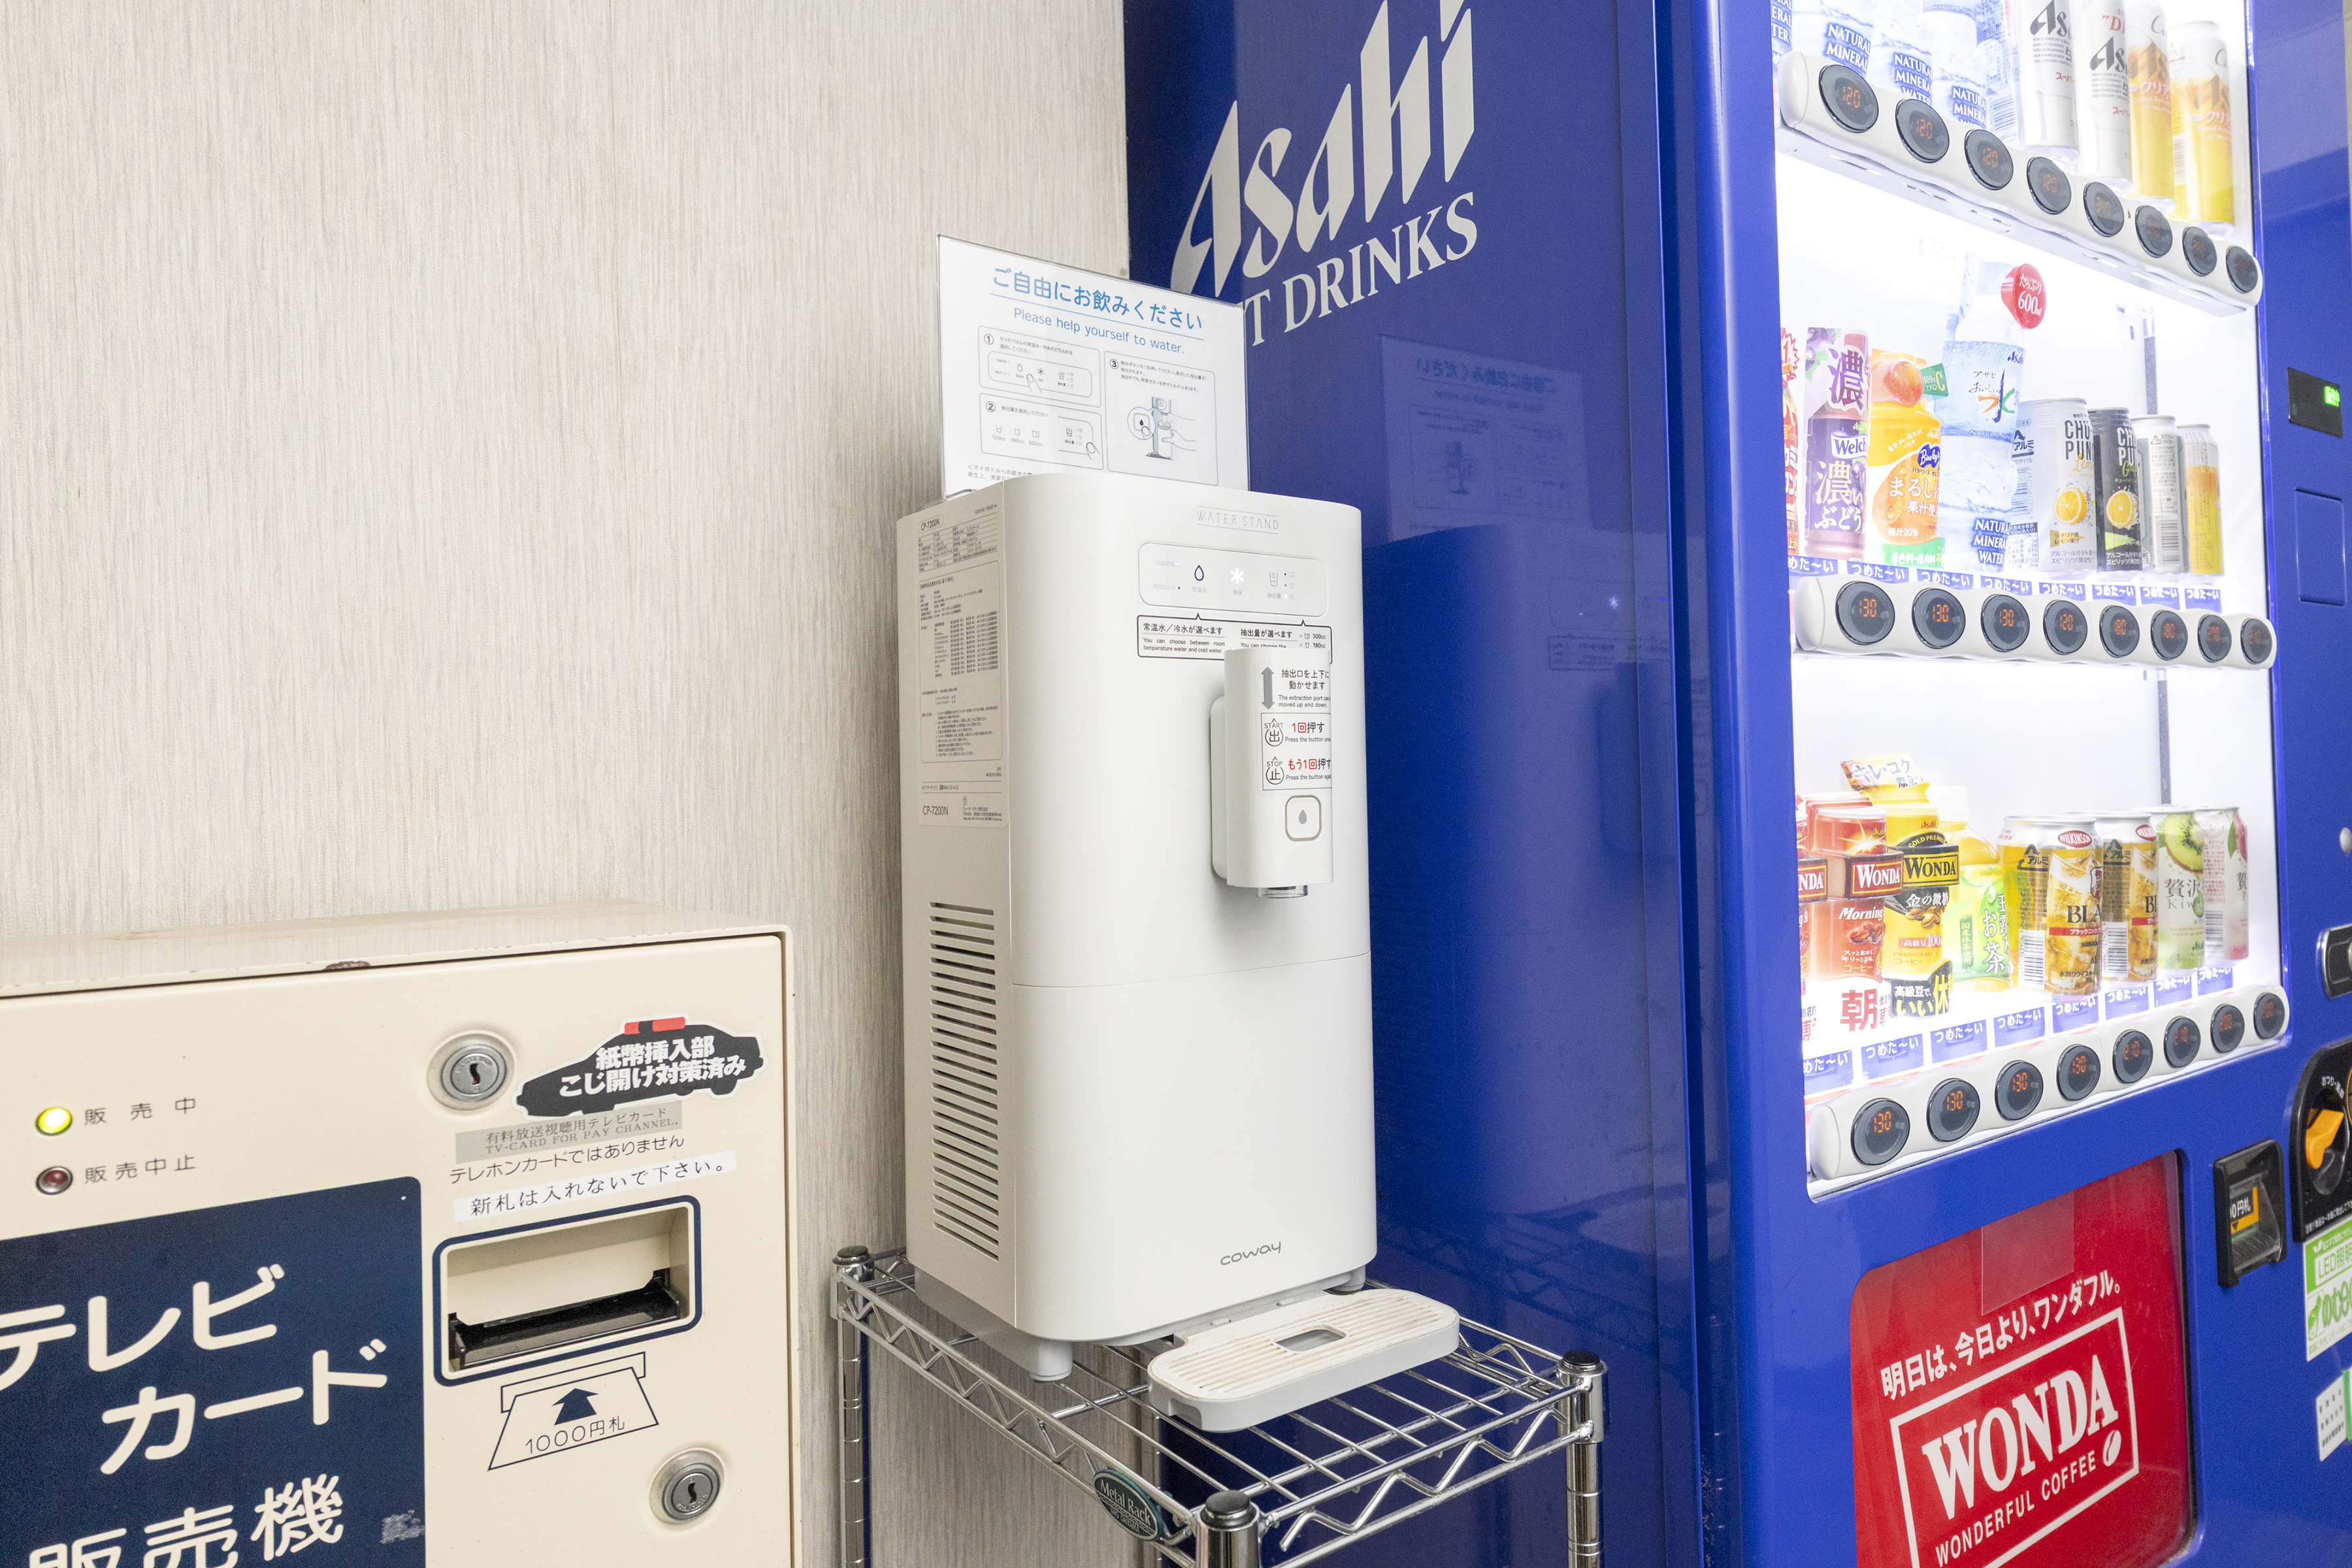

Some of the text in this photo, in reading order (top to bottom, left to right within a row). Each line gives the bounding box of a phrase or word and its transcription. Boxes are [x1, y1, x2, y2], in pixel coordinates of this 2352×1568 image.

[1842, 86, 1861, 109] 120
[1916, 118, 1933, 140] 120
[1170, 0, 1475, 298] Asahi
[1983, 148, 1999, 168] 120
[1282, 191, 1478, 333] DRINKS
[2017, 272, 2043, 295] たっぷり
[992, 267, 1203, 331] ご自由にお飲みください
[1014, 307, 1185, 355] Please help yourself to water.
[1828, 346, 1865, 410] 濃
[1972, 370, 1997, 379] アサヒ
[1968, 382, 1999, 393] おいしい
[1978, 368, 2016, 423] 水
[2014, 440, 2034, 451] アルミ
[1814, 461, 1864, 506] 濃い
[1196, 510, 1279, 531] WATER STAND
[1815, 504, 1863, 532] ぶどう
[1887, 528, 1919, 537] 果汁20%
[1978, 550, 2004, 566] WATER
[1859, 598, 1878, 618] 130
[1932, 604, 1950, 623] 130
[1999, 609, 2015, 627] 130
[1143, 622, 1224, 636] 常温水／冷水が選べます
[2059, 613, 2074, 631] 120
[1240, 628, 1293, 639] 抽出量が選べます
[1281, 668, 1330, 679] 抽出口を上下に
[1288, 680, 1326, 691] 動かせます
[1292, 721, 1325, 734] 1回押す
[1269, 768, 1281, 781] 止
[1288, 758, 1331, 770] もう1回押す
[1853, 757, 1910, 783] キレ・コク
[923, 805, 949, 816] CP-7200N
[1908, 836, 1926, 849] GOLD
[2059, 832, 2091, 845] WILKINSON
[2027, 855, 2049, 866] アルミ
[2110, 850, 2131, 860] アルミ
[1855, 863, 1901, 889] WONDA
[1903, 856, 1957, 879] WONDA
[1838, 906, 1884, 921] Morning
[1895, 985, 1932, 998] 高級豆で、
[1840, 988, 1878, 1032] 朝
[1997, 1009, 2042, 1029] つめた〜い
[1935, 1022, 1984, 1043] つめた〜い
[595, 1035, 715, 1070] 紙幣挿入部
[1865, 1037, 1919, 1059] つめた〜い
[2071, 1054, 2086, 1075] 130
[559, 1054, 747, 1098] こじ開け対策済み
[2012, 1071, 2028, 1092] 130
[1946, 1090, 1963, 1111] 130
[485, 1107, 667, 1145] 有料放送視聴用テレビカード
[1873, 1111, 1892, 1133] 130
[485, 1118, 679, 1155] TV-CARD FOR PAY CHANNEL.
[84, 1154, 196, 1184] 販売中止
[449, 1135, 685, 1184] テレホンカードではありません
[470, 1160, 725, 1217] 新札は入れないで下さい。
[1220, 1241, 1281, 1266] coway
[0, 1264, 286, 1390] テレビ
[1880, 1269, 2121, 1401] 明日は、今日より、ワンダフル。
[100, 1339, 388, 1475] カード
[525, 1415, 625, 1454] 1000円札
[1921, 1354, 2119, 1521] WONDA
[1100, 1478, 1151, 1526] Metal Rack
[1935, 1450, 2097, 1568] WONDERFUL COFFEE
